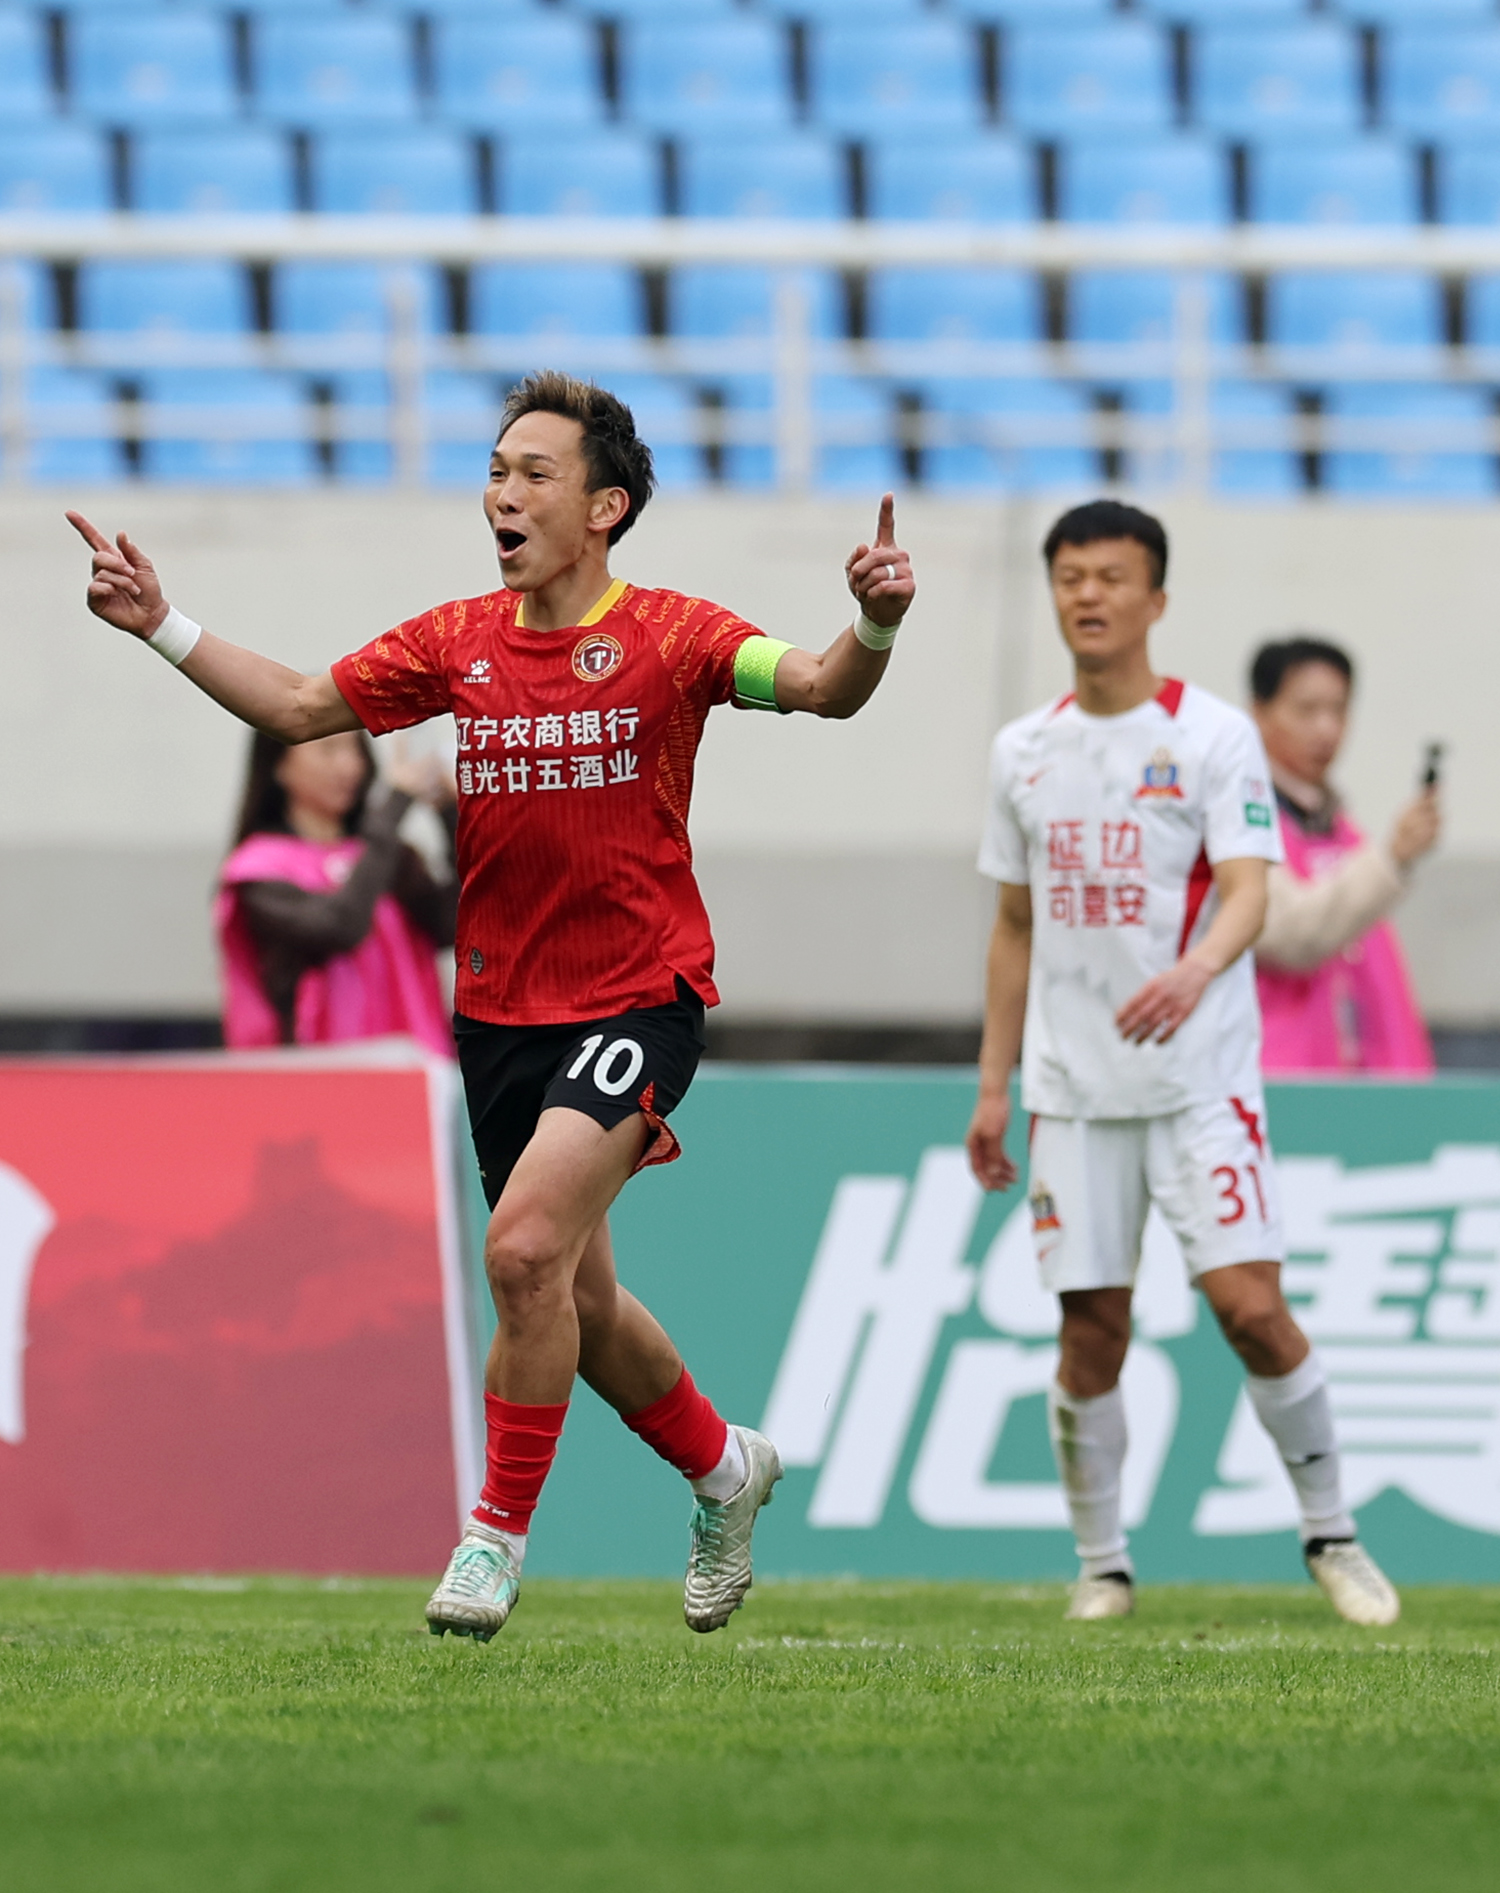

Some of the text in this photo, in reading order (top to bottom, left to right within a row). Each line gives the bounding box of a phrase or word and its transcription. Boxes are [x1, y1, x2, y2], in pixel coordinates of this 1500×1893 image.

[457, 706, 640, 751] 辽宁农商银行
[459, 748, 640, 795] 道光廿五酒业
[1047, 821, 1143, 870] 延边
[566, 1033, 644, 1096] 10
[1209, 1165, 1267, 1226] 31
